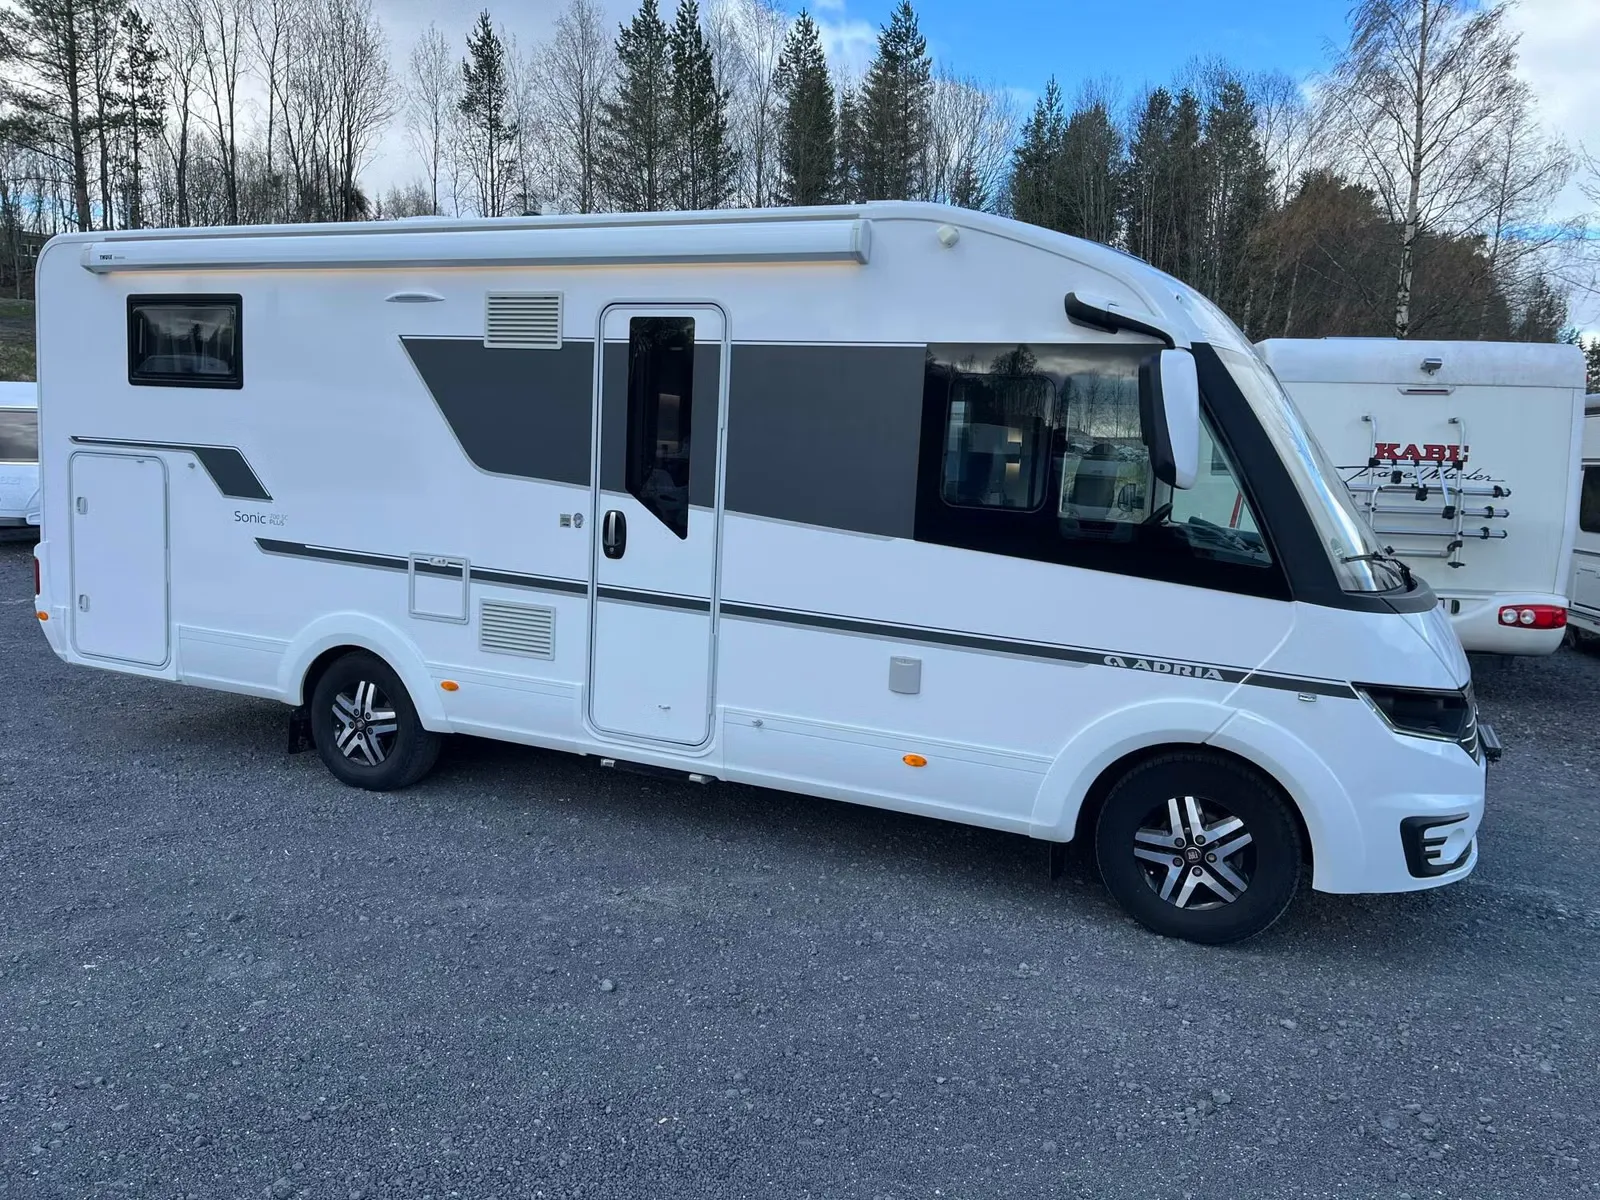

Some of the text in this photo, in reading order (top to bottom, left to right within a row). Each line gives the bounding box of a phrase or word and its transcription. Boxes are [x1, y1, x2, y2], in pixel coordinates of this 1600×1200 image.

[1374, 443, 1469, 462] KABE
[234, 510, 267, 524] Sonic
[1132, 659, 1224, 680] ADRIA
